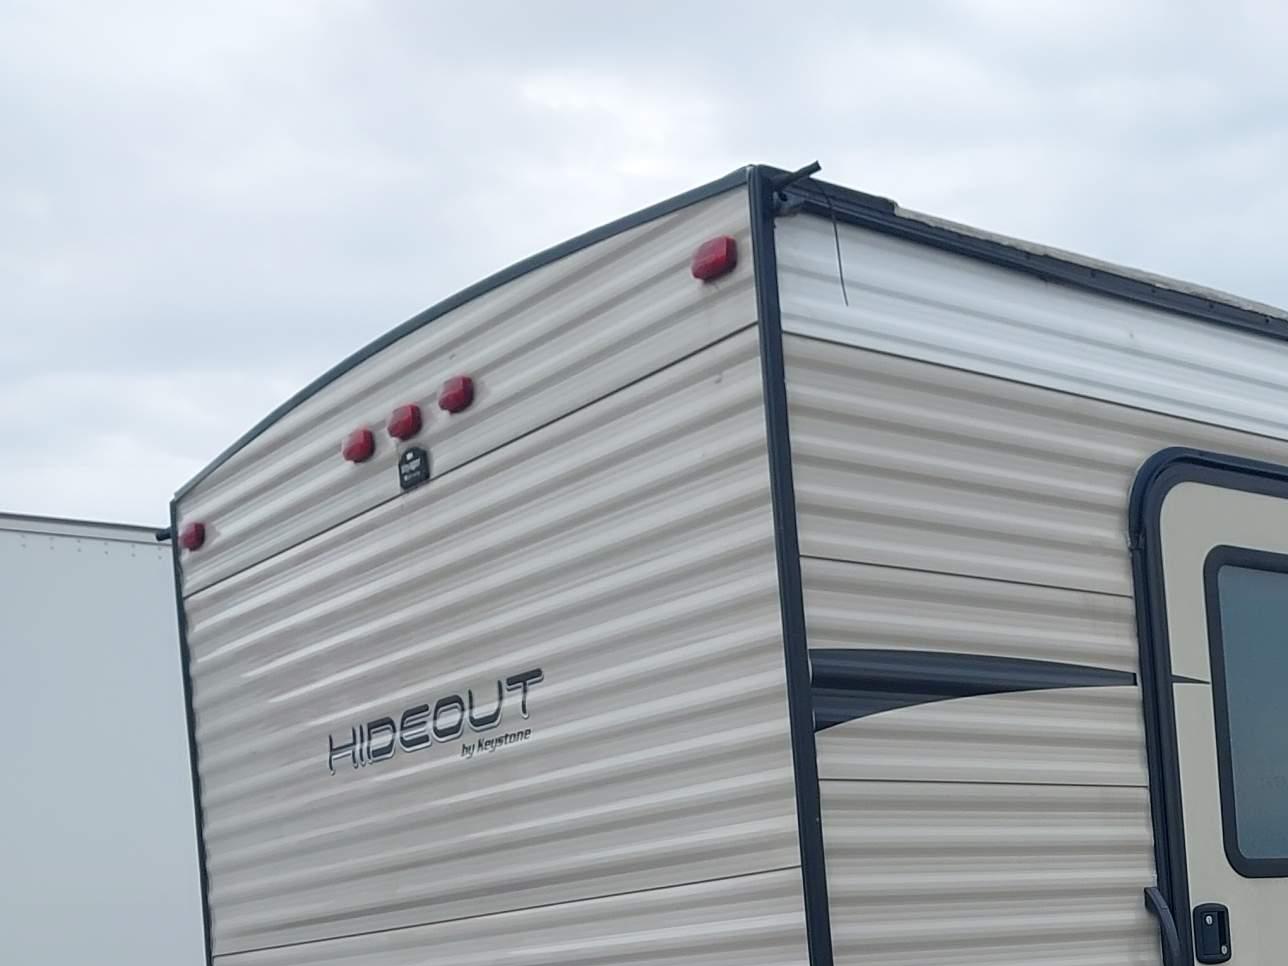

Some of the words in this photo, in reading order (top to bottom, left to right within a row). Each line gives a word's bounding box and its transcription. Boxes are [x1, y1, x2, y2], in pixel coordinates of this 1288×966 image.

[328, 668, 544, 775] HIDEOUT
[461, 743, 475, 758] by
[477, 728, 532, 753] Keystone
